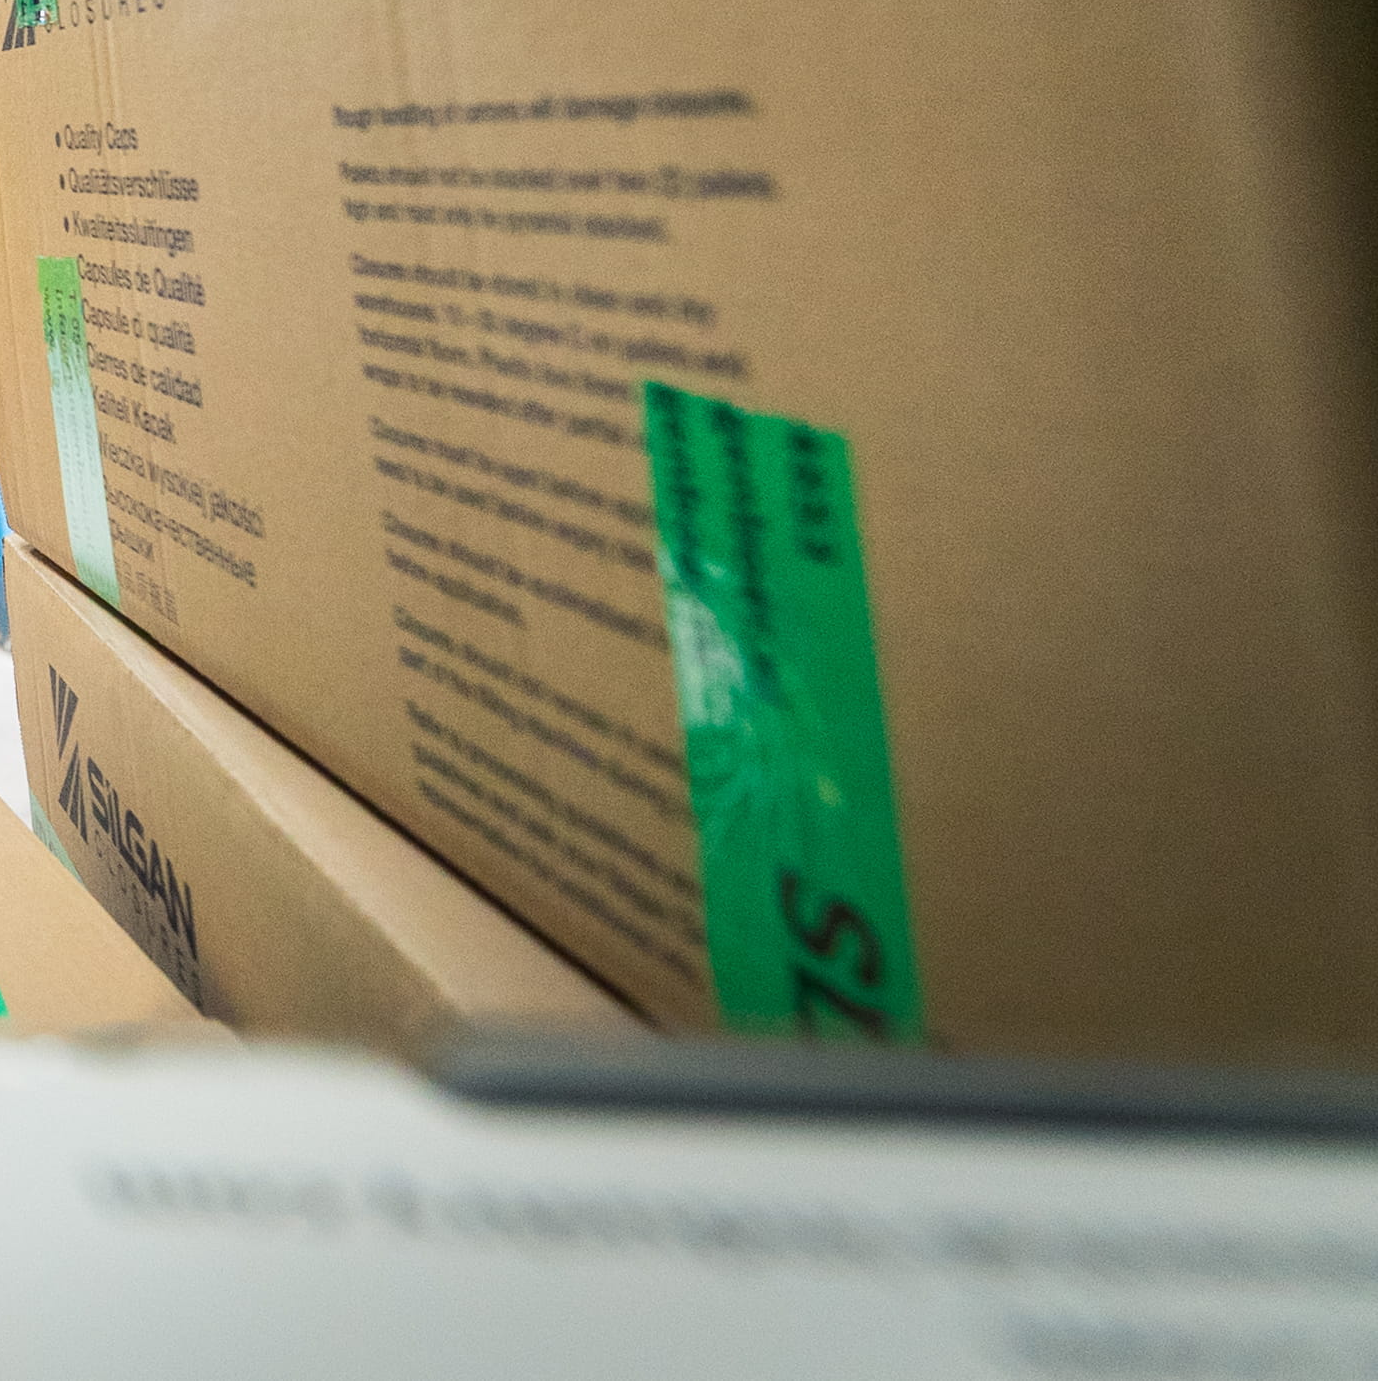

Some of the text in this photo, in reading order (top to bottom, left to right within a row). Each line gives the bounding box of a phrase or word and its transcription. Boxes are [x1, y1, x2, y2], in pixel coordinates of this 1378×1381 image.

[64, 122, 139, 156] Quality Caps
[78, 254, 132, 290] Capsules
[82, 298, 130, 336] Capsule
